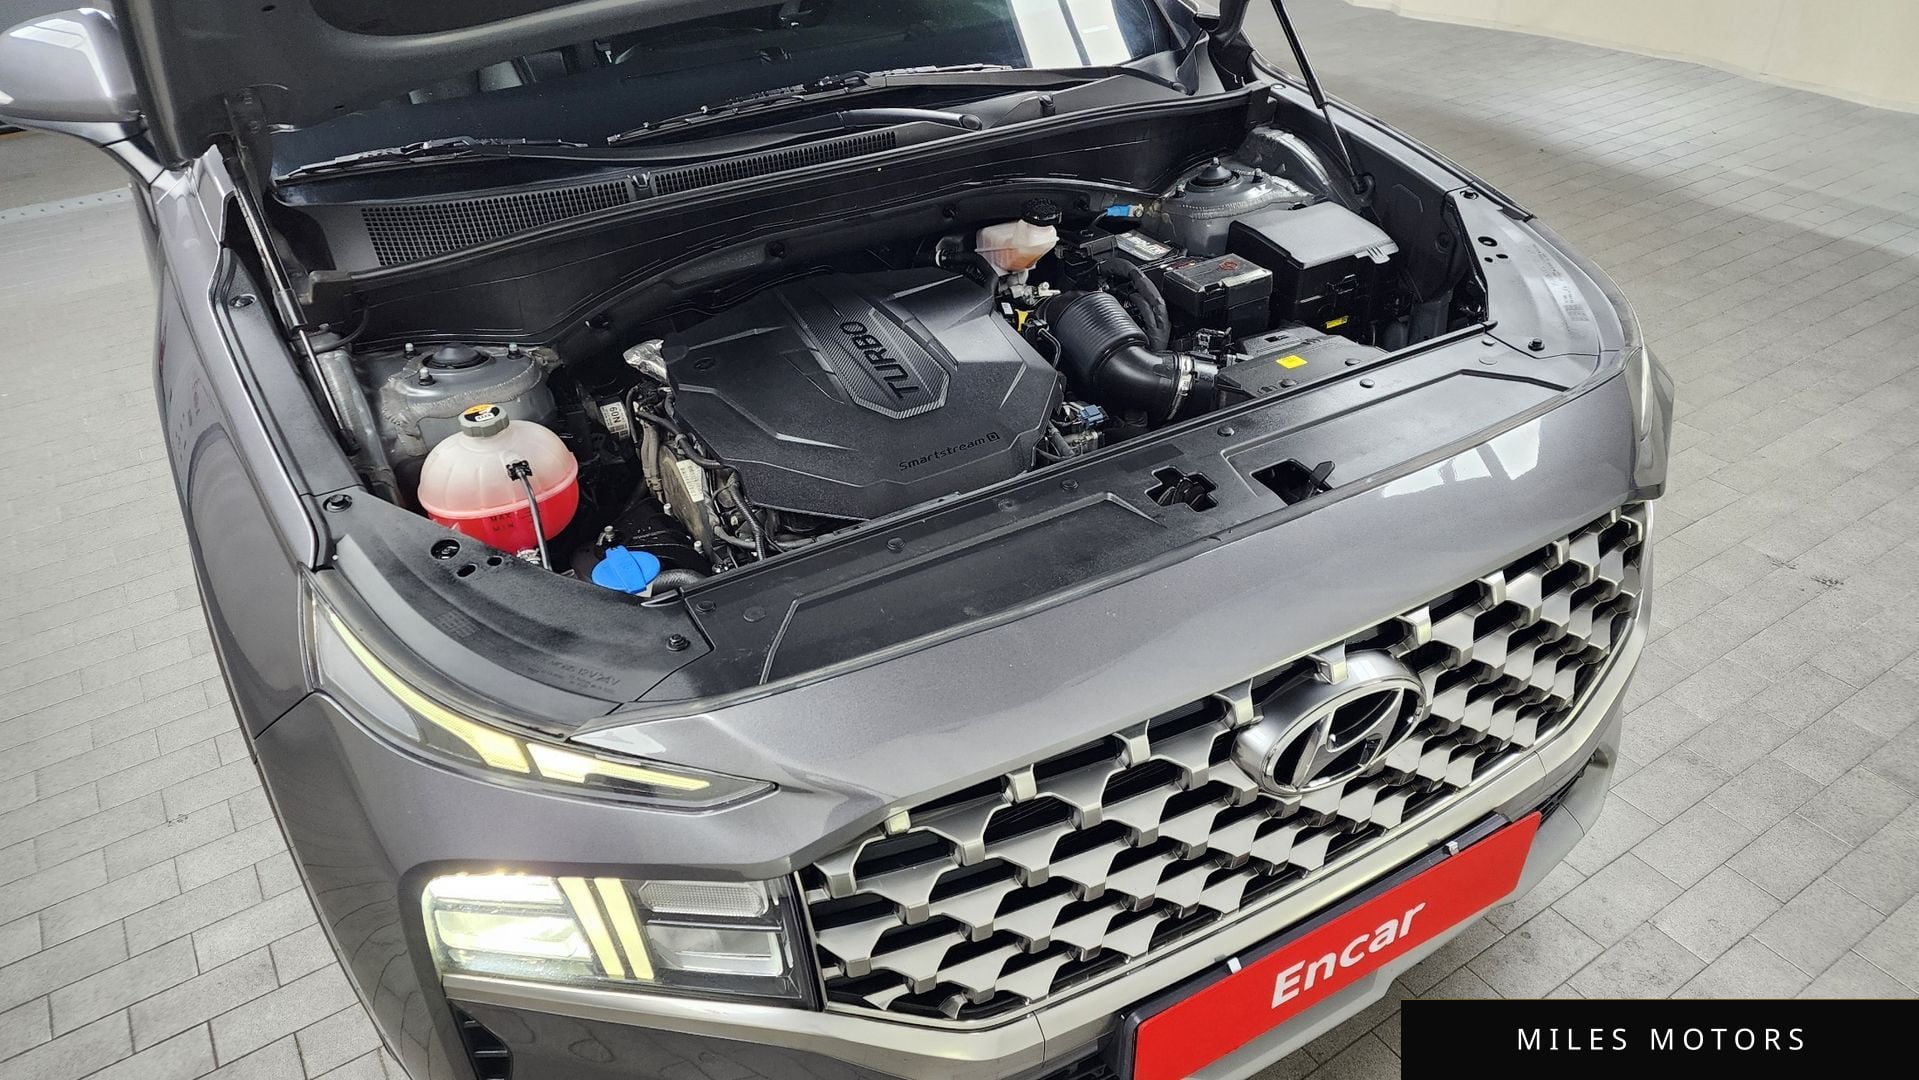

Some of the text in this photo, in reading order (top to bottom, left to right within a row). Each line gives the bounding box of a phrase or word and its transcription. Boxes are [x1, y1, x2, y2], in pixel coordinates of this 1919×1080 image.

[840, 321, 920, 399] TURBO
[898, 438, 986, 471] Smartstream
[1271, 902, 1427, 1010] Encar
